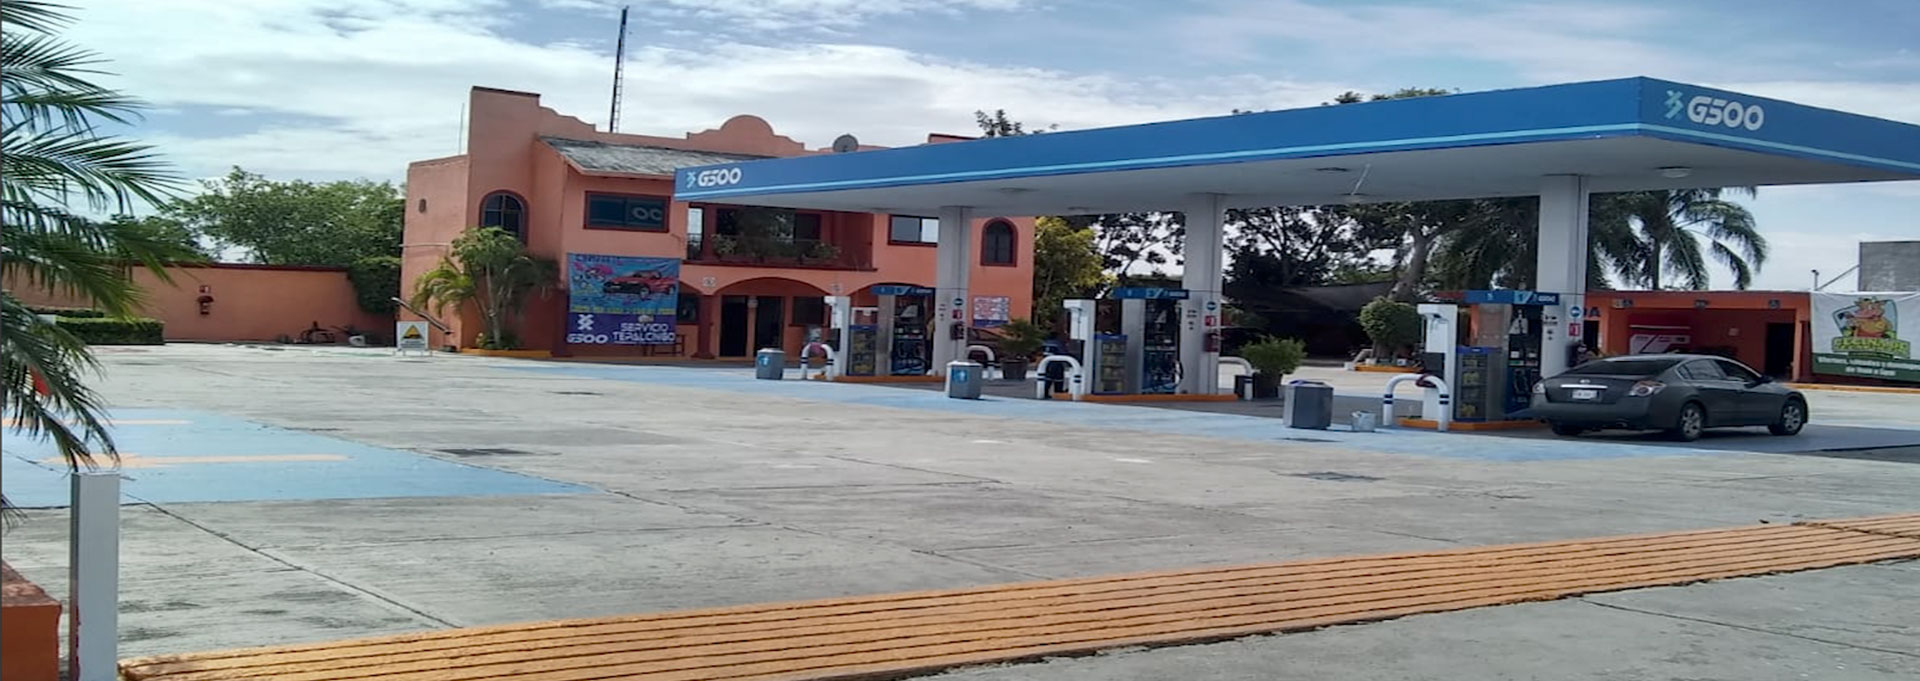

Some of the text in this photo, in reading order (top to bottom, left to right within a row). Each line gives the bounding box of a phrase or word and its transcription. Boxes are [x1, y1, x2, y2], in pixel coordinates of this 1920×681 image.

[1687, 95, 1764, 131] G500
[697, 167, 742, 187] G500
[620, 323, 668, 332] SERVICIO
[567, 333, 608, 344] G500
